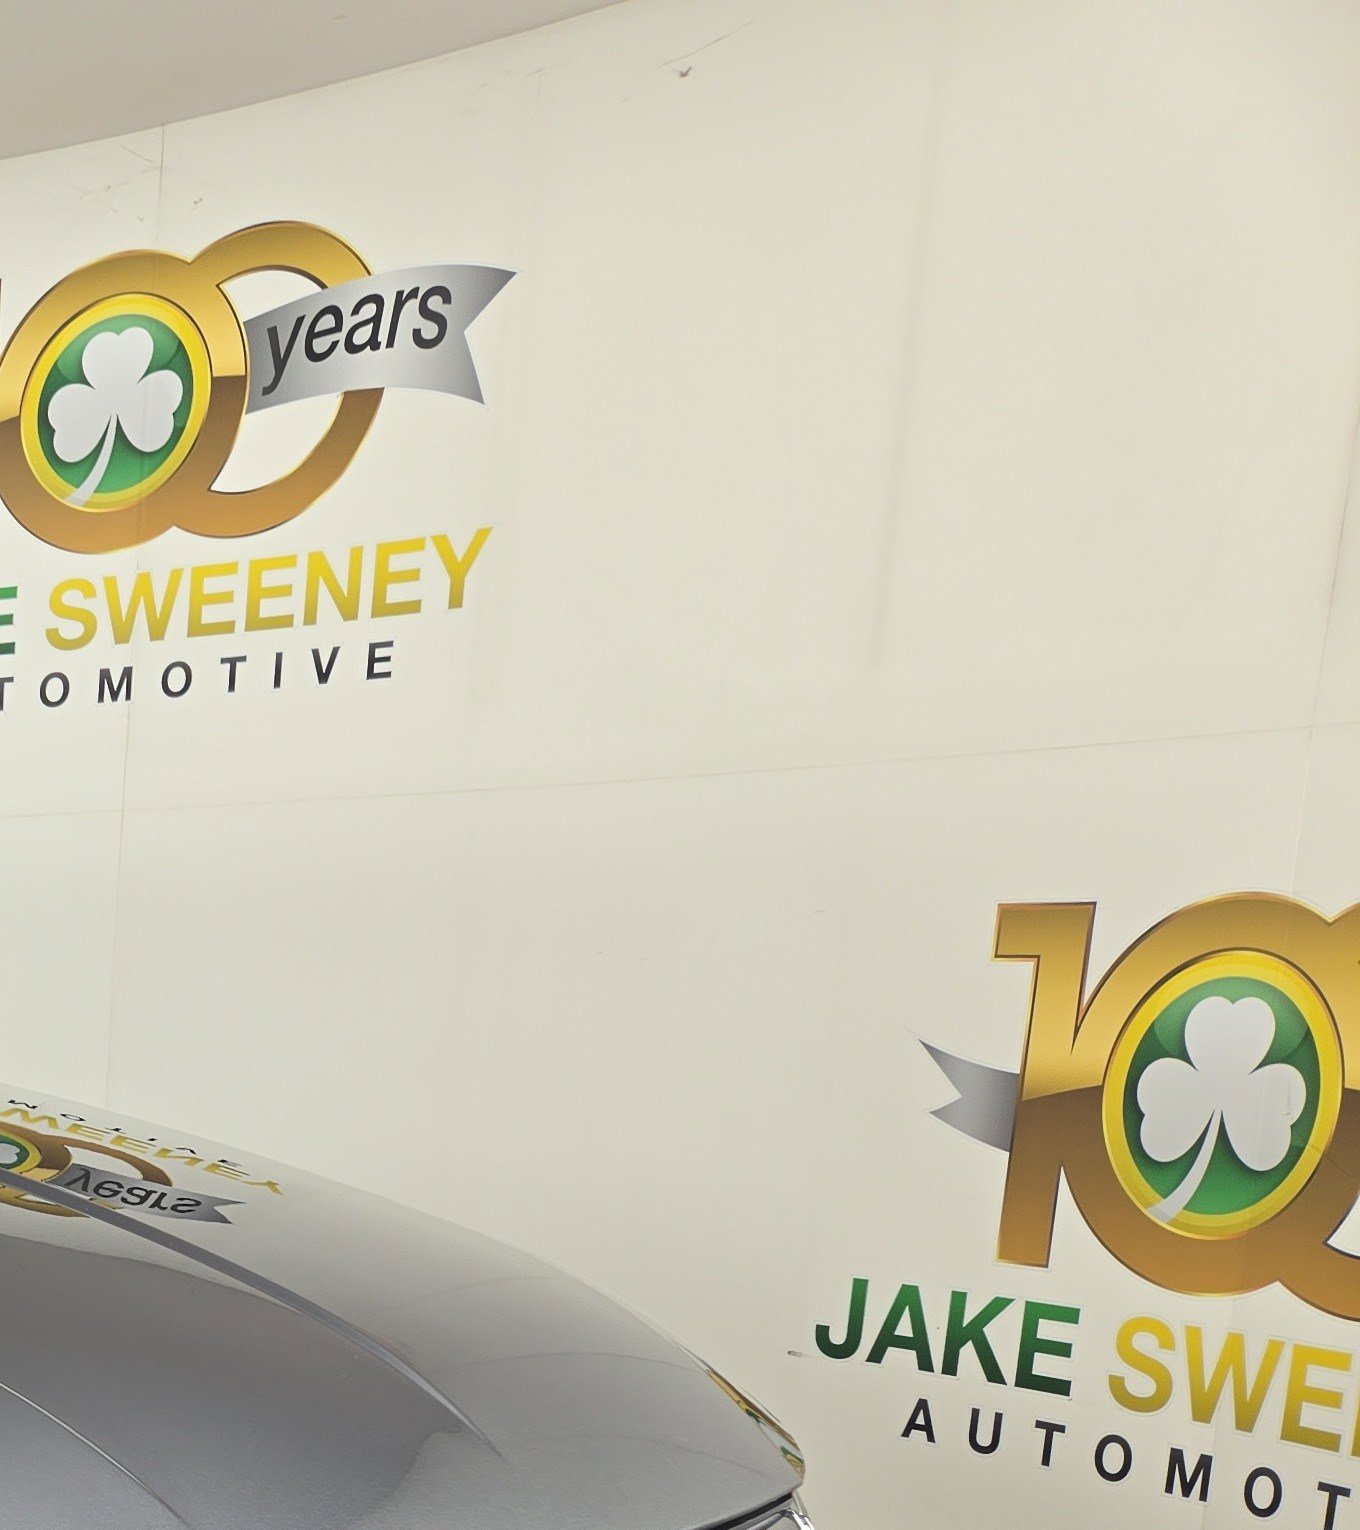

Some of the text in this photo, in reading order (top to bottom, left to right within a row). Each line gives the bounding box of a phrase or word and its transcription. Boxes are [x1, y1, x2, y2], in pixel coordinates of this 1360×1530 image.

[261, 284, 452, 396] years
[45, 526, 493, 651] SWEENEY
[815, 1277, 1360, 1459] JAKE SWE
